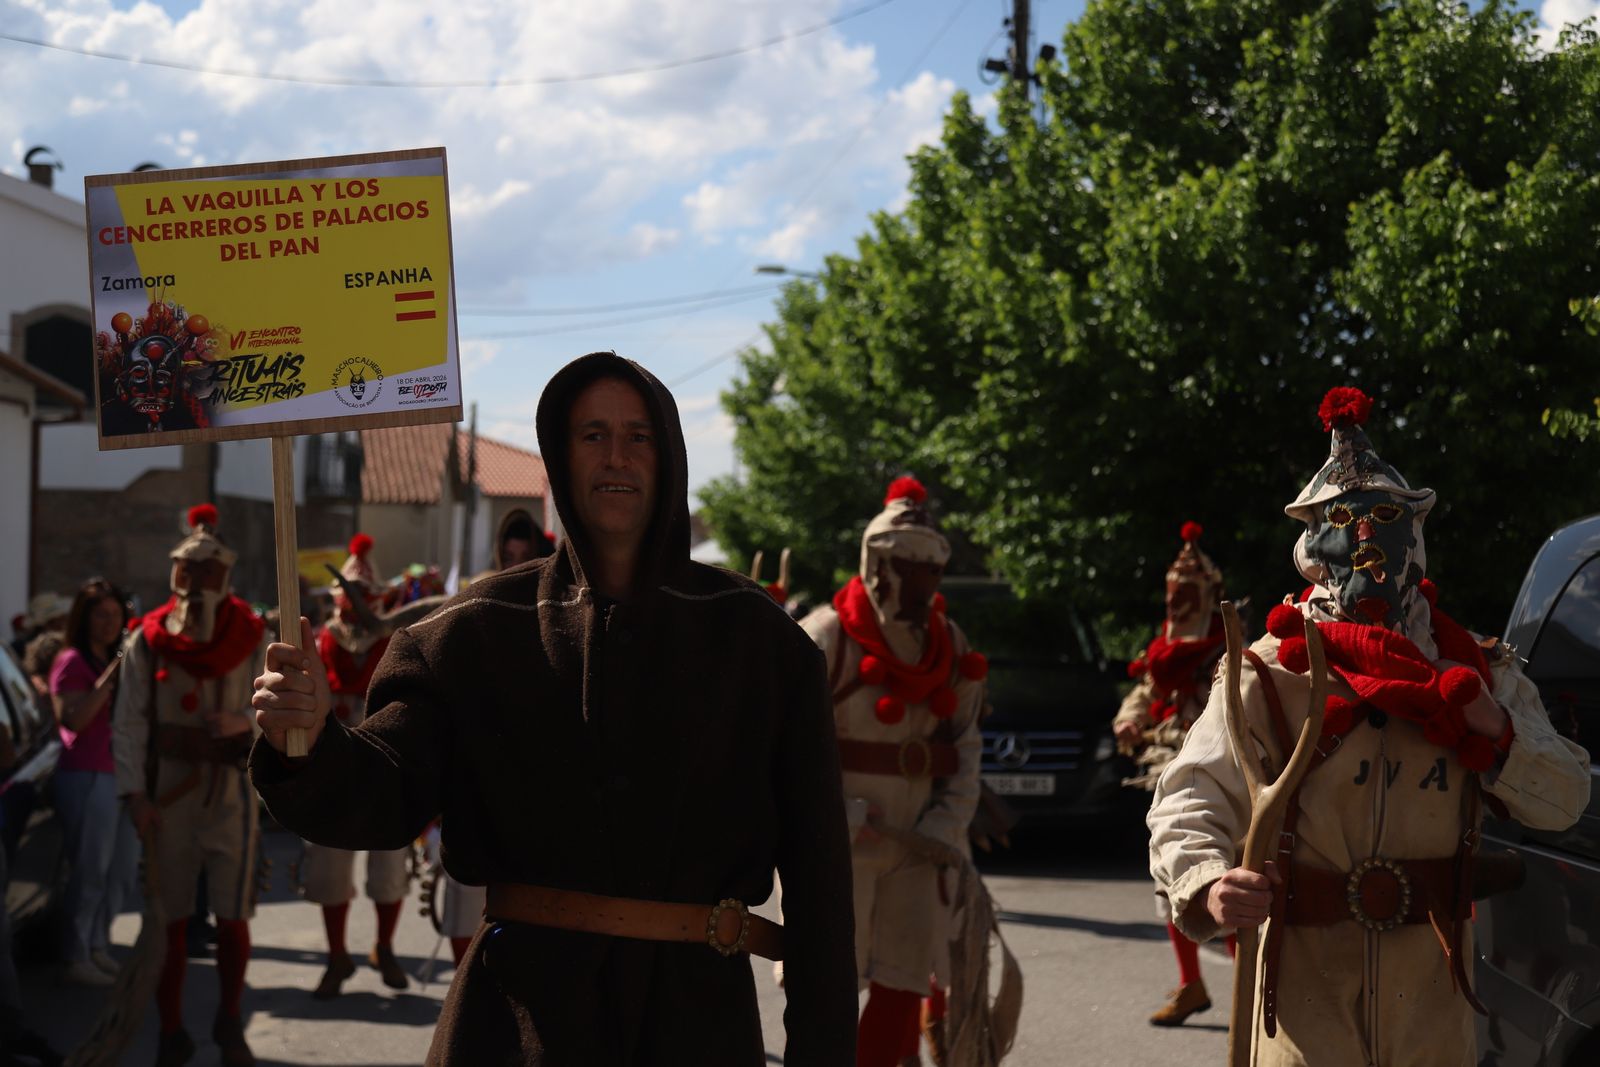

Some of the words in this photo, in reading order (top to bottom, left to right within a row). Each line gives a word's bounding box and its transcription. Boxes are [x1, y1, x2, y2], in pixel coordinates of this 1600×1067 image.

[146, 196, 175, 216] LA
[183, 186, 303, 212] VAQUILLA
[310, 183, 326, 202] Y
[335, 178, 380, 200] LOS
[98, 215, 267, 246] CENCERREROS
[276, 211, 304, 232] DE
[313, 200, 430, 228] PALACIOS
[220, 242, 262, 262] DEL
[269, 236, 319, 258] PAN
[101, 274, 176, 292] Zamora
[344, 266, 433, 289] ESPANHA
[230, 330, 246, 350] VI
[249, 326, 301, 340] ENCONTRO
[331, 356, 384, 386] MASCHOCALHEIRO
[1354, 759, 1370, 785] J
[1419, 757, 1449, 792] A
